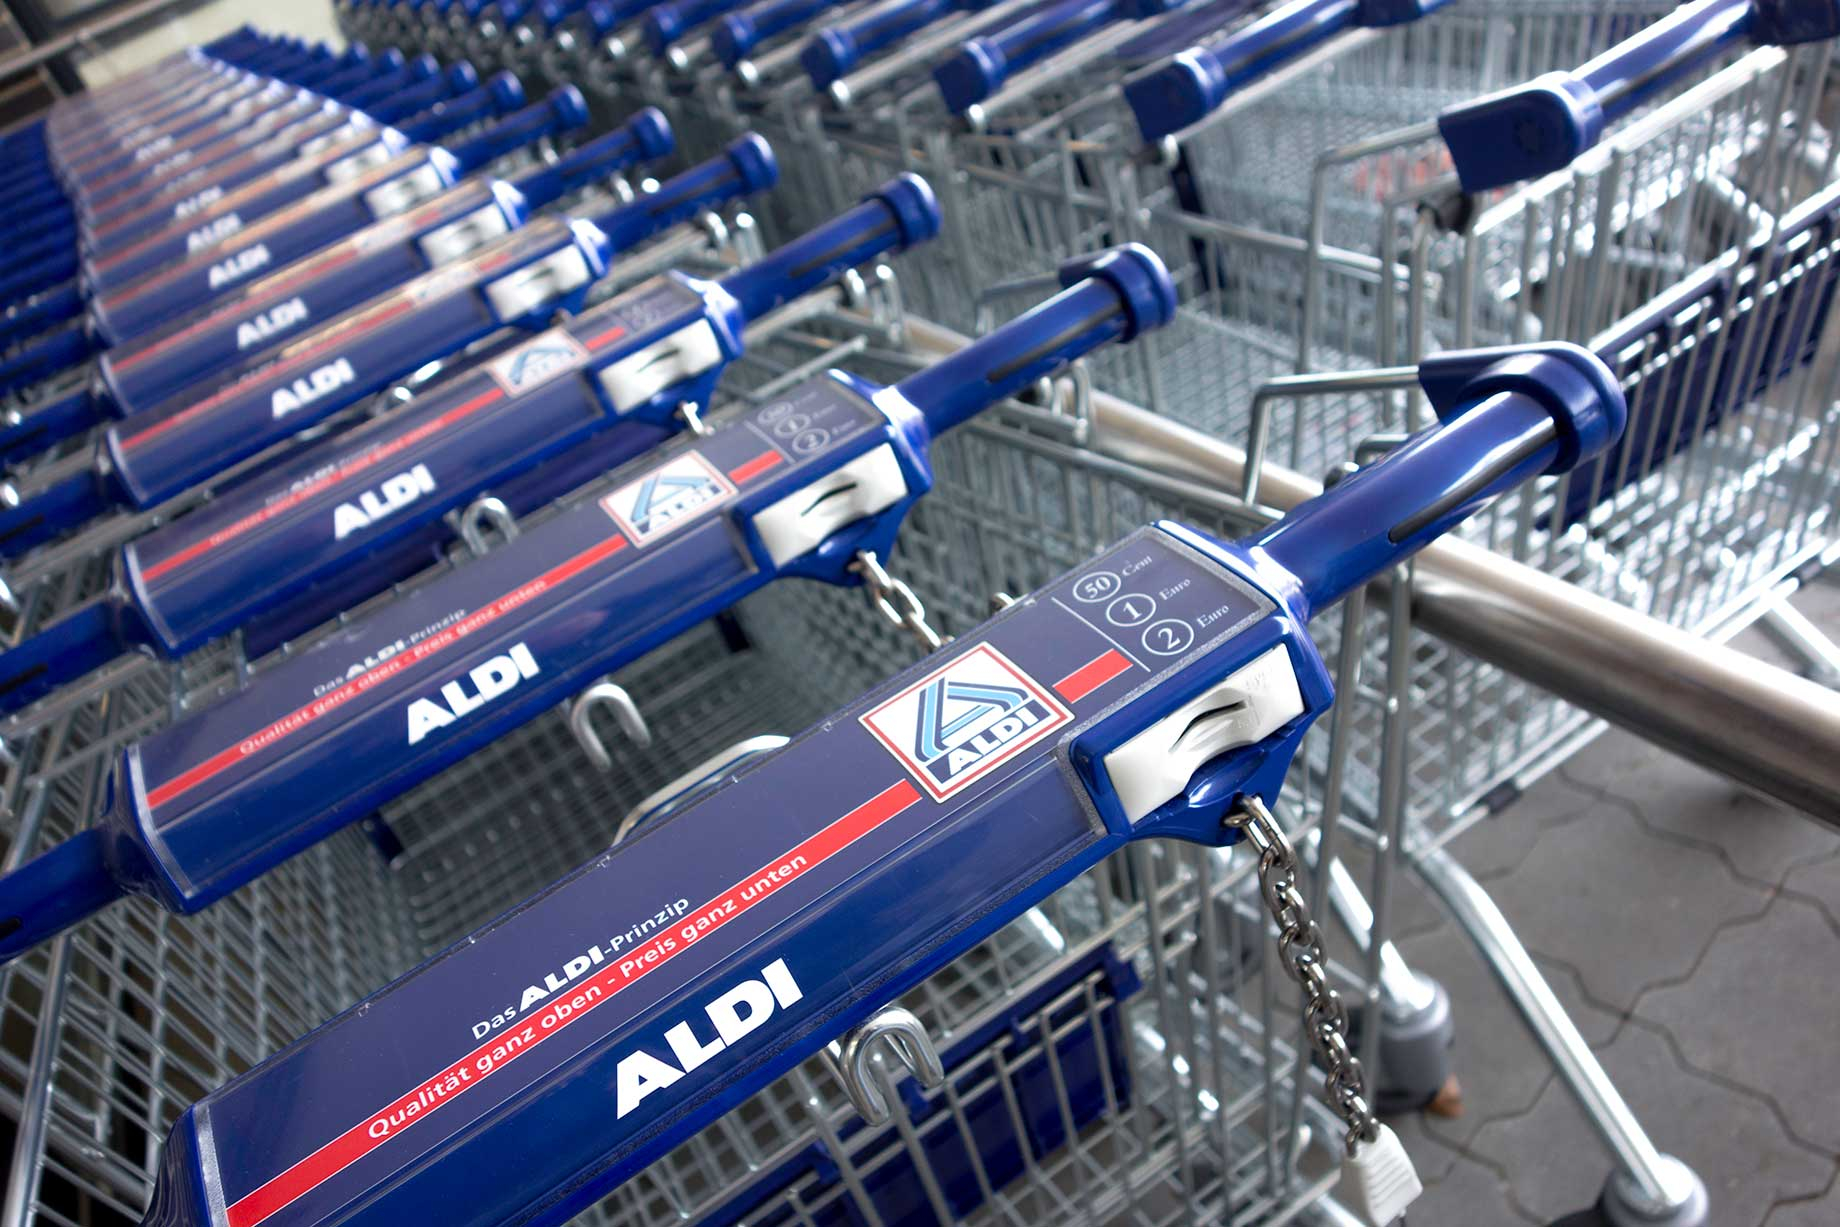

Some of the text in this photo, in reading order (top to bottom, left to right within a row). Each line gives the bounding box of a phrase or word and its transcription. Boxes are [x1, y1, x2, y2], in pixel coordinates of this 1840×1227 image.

[209, 244, 270, 288] ALDI
[237, 297, 308, 348] ALDI
[272, 357, 355, 419] ALDI
[333, 463, 436, 541] ALDI
[1084, 576, 1111, 599] 50
[1159, 577, 1192, 600] Euro
[1158, 604, 1230, 650] 2 Euro
[407, 642, 540, 745] ALDI
[945, 701, 1041, 776] ALDI
[368, 1067, 472, 1138] Qualität
[476, 1027, 536, 1074] ganz
[541, 985, 602, 1029] oben
[619, 936, 677, 978] Preis
[680, 899, 738, 943] ganz
[740, 855, 808, 901] unten
[472, 1006, 517, 1040] Das
[616, 958, 804, 1120] ALDI
